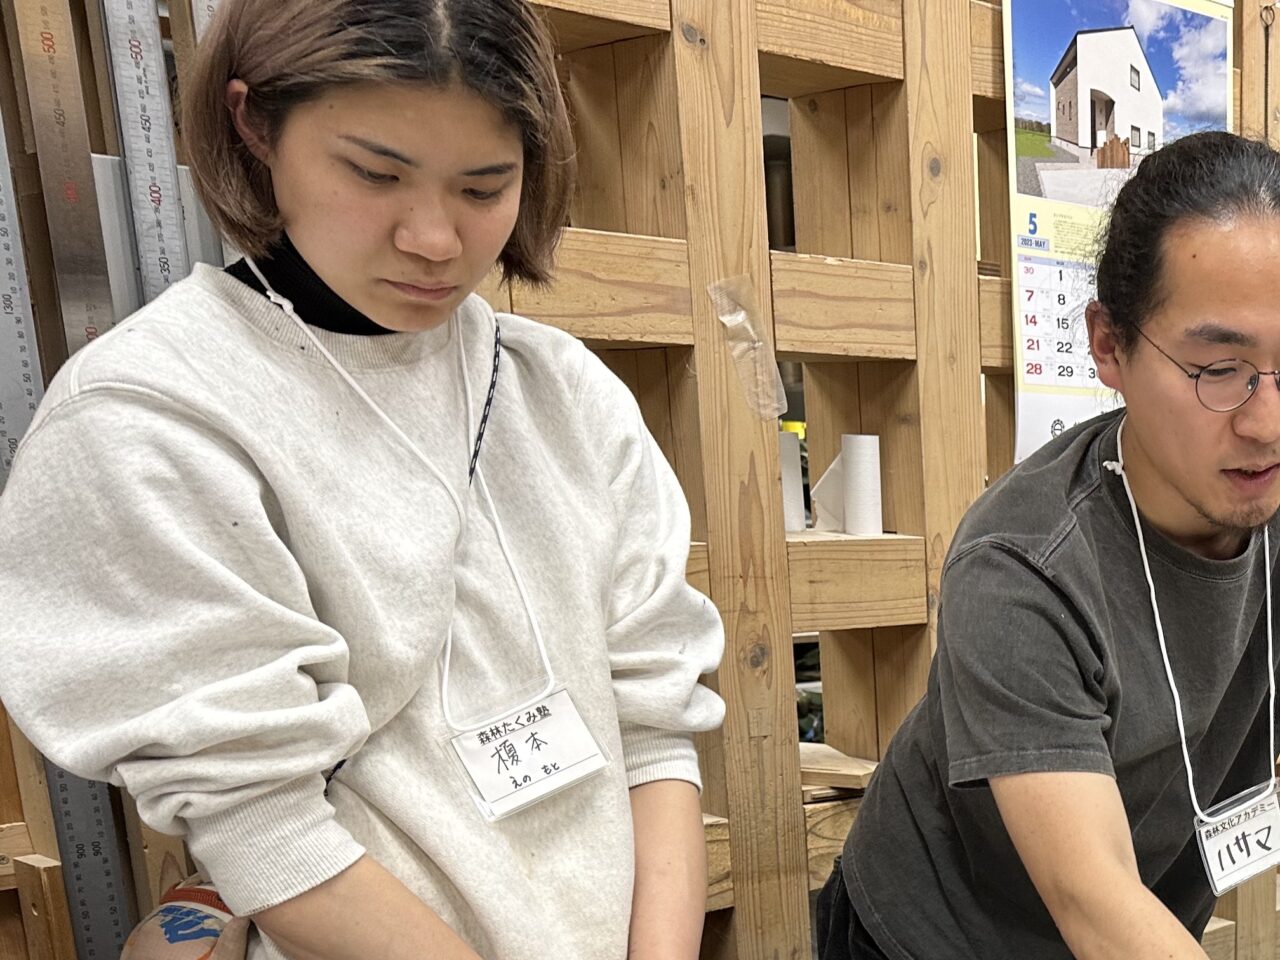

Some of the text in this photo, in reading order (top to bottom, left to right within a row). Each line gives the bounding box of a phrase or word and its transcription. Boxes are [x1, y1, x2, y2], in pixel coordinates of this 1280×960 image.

[40, 32, 55, 54] 500
[129, 38, 143, 60] 500
[140, 115, 152, 133] 450
[149, 185, 162, 206] 400
[1028, 212, 1038, 235] 5
[159, 257, 170, 275] 350
[1023, 266, 1034, 275] 30
[1058, 270, 1063, 282] 1
[1025, 290, 1066, 305] 7 8
[1024, 314, 1069, 330] 14 15
[1026, 339, 1072, 354] 21 22
[1026, 363, 1042, 375] 28
[1058, 365, 1074, 377] 29
[476, 704, 551, 746] 森林たくみ塾
[491, 731, 548, 775] 榎本
[1204, 801, 1275, 840] 森林文化アカデミー
